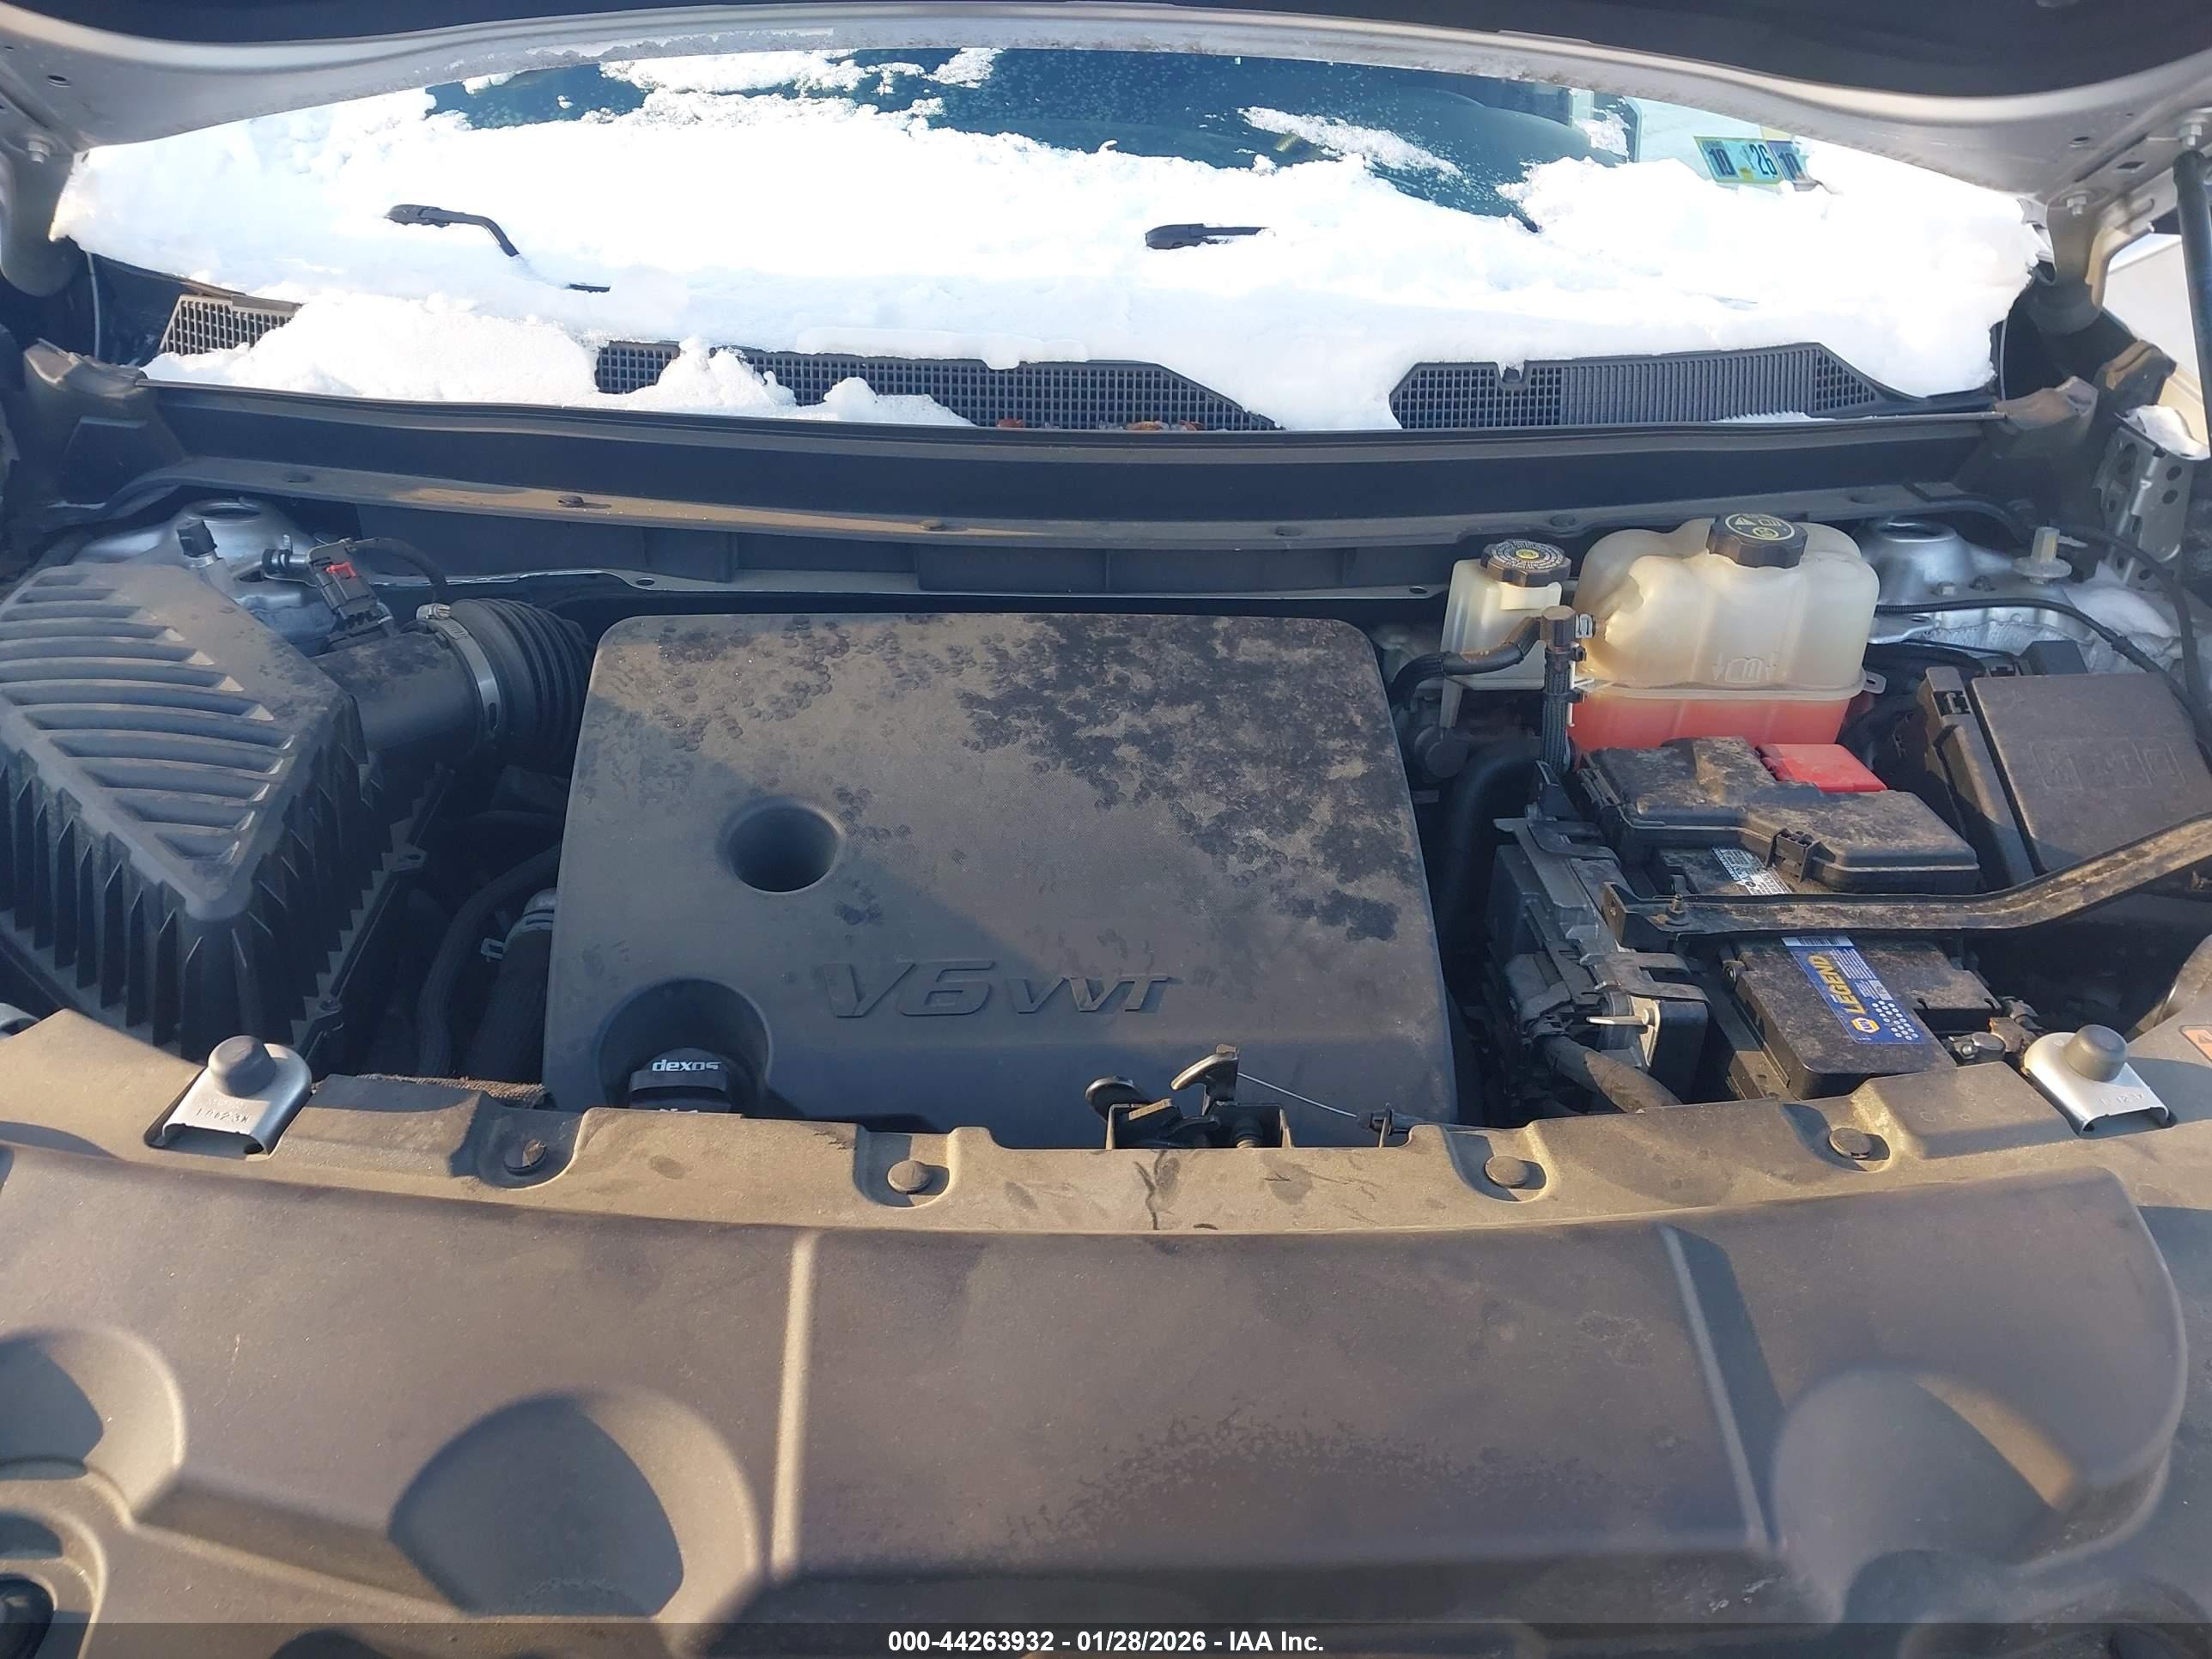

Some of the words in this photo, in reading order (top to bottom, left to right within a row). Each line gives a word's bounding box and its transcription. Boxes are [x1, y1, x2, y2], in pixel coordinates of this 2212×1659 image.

[1709, 148, 1735, 175] 10
[823, 959, 995, 1018] V6
[1007, 975, 1169, 1014] VVT
[1807, 954, 1867, 1014] LEGEND
[653, 1059, 722, 1072] dexos
